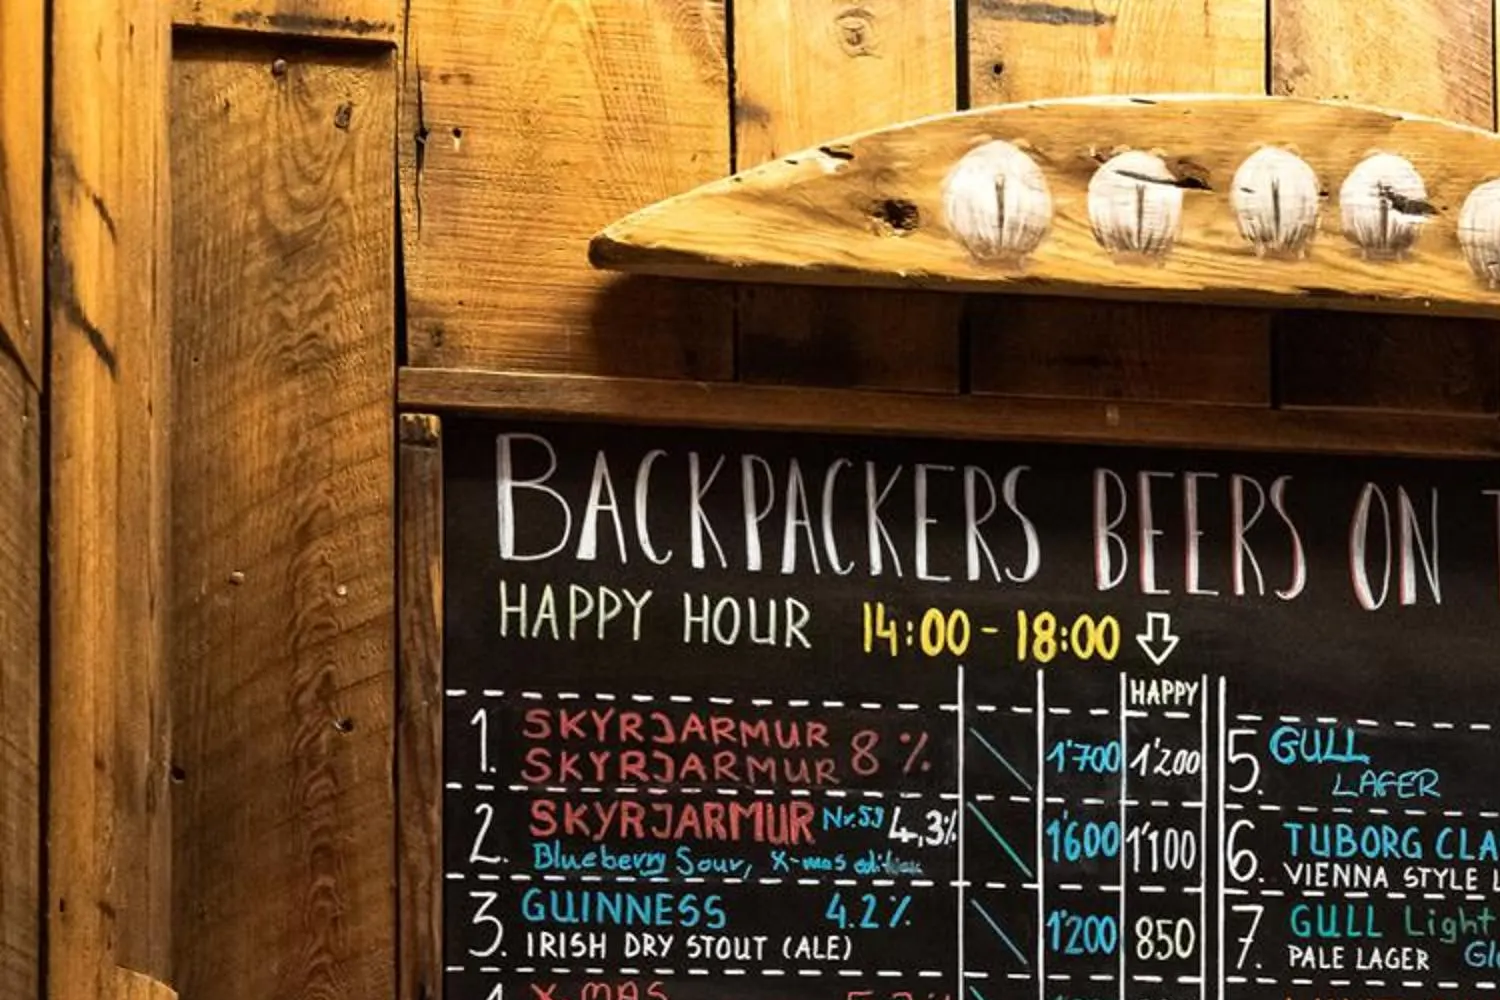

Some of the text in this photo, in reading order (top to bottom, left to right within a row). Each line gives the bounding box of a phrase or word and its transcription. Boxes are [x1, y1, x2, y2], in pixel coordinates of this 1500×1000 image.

[497, 433, 1040, 582] BACKPACKERS
[1095, 471, 1306, 600] BEERS
[1351, 483, 1441, 610] ON
[500, 580, 652, 641] HAPPY
[684, 592, 811, 648] HOUR
[864, 602, 970, 656] 14:00
[1018, 610, 1120, 662] 18:00
[1131, 679, 1198, 706] HAPPY
[471, 708, 496, 773] 1.
[523, 708, 830, 748] SKYRJARMUR
[852, 730, 878, 774] 8
[521, 748, 840, 785] SKYRJARMUR
[1228, 725, 1370, 795] 5. GULL
[469, 803, 508, 863] 2.
[528, 800, 814, 845] SKYRJARMUR
[1228, 819, 1264, 882] 6.
[1284, 823, 1422, 858] TUBORG
[1283, 863, 1388, 888] VIENNA
[1404, 867, 1477, 890] STYLE
[469, 891, 507, 957] 3.
[522, 888, 726, 929] GUINNESS
[528, 931, 851, 960] IRISH DRY STOUT (ALE)
[1135, 916, 1195, 960] 850
[1232, 904, 1496, 969] 7. GULL Light
[1288, 945, 1344, 969] PALE
[1356, 947, 1429, 970] LAGER
